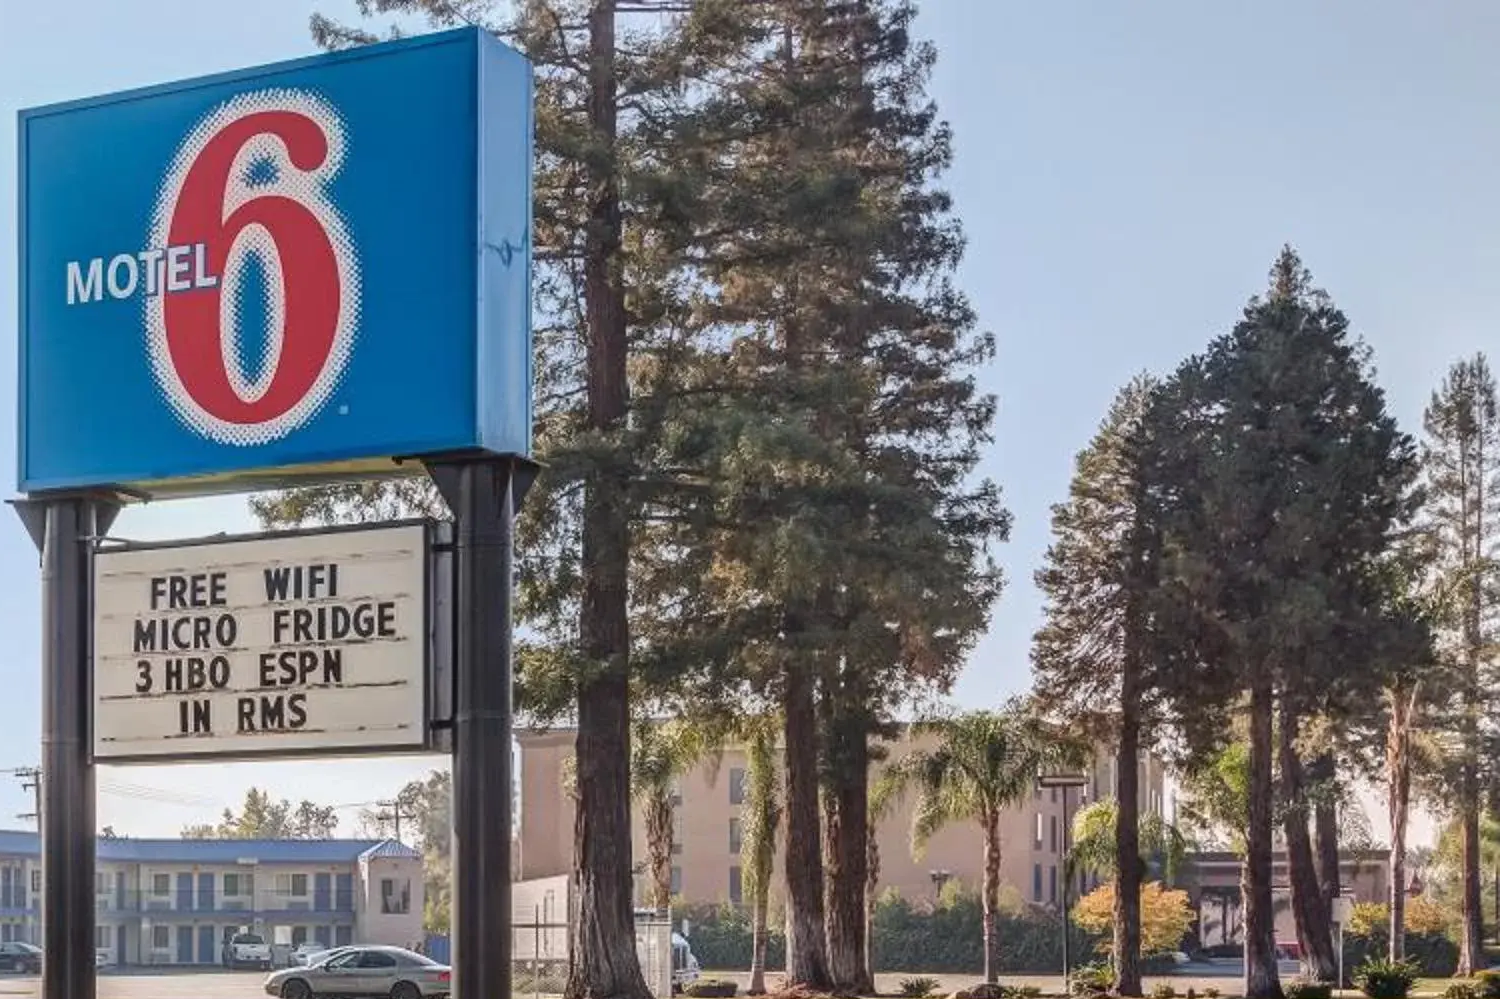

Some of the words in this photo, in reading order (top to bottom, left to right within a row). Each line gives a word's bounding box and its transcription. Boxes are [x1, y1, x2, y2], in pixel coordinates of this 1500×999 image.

[66, 243, 218, 305] MOTEL
[156, 100, 348, 434] 6
[150, 572, 227, 610] FREE
[264, 563, 338, 600] WIFI
[133, 613, 237, 652] MICRO
[273, 601, 396, 642] FRIDGE
[135, 660, 153, 692] 3
[165, 655, 230, 691] HBO
[259, 649, 342, 687] ESPN
[179, 699, 211, 732] IN
[237, 693, 308, 732] RMS
